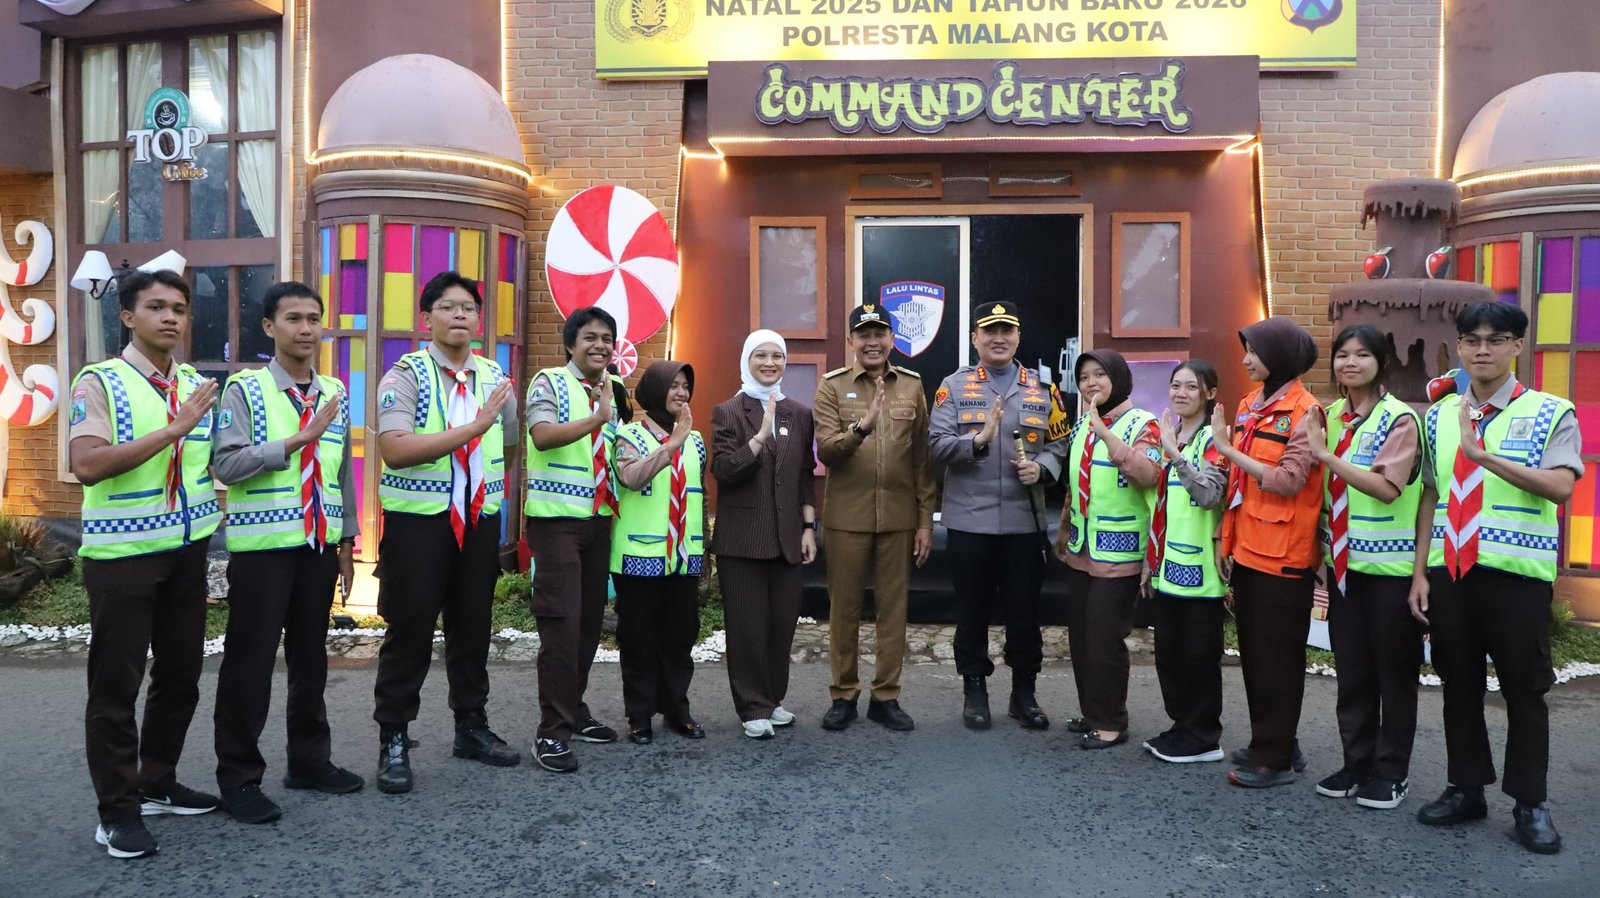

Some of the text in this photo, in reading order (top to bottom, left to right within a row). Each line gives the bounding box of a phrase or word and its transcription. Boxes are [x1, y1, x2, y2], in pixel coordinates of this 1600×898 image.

[706, 0, 801, 16] NATAL
[810, 0, 881, 15] 2025
[892, 0, 952, 13] DAN
[783, 20, 1168, 46] POLRESTA MALANG KOTA
[760, 66, 1188, 126] COMMAND CENTER
[126, 127, 207, 163] TOP
[886, 284, 939, 296] LALU LINTAS
[959, 400, 987, 408] NANANG
[1022, 403, 1046, 413] POLRI
